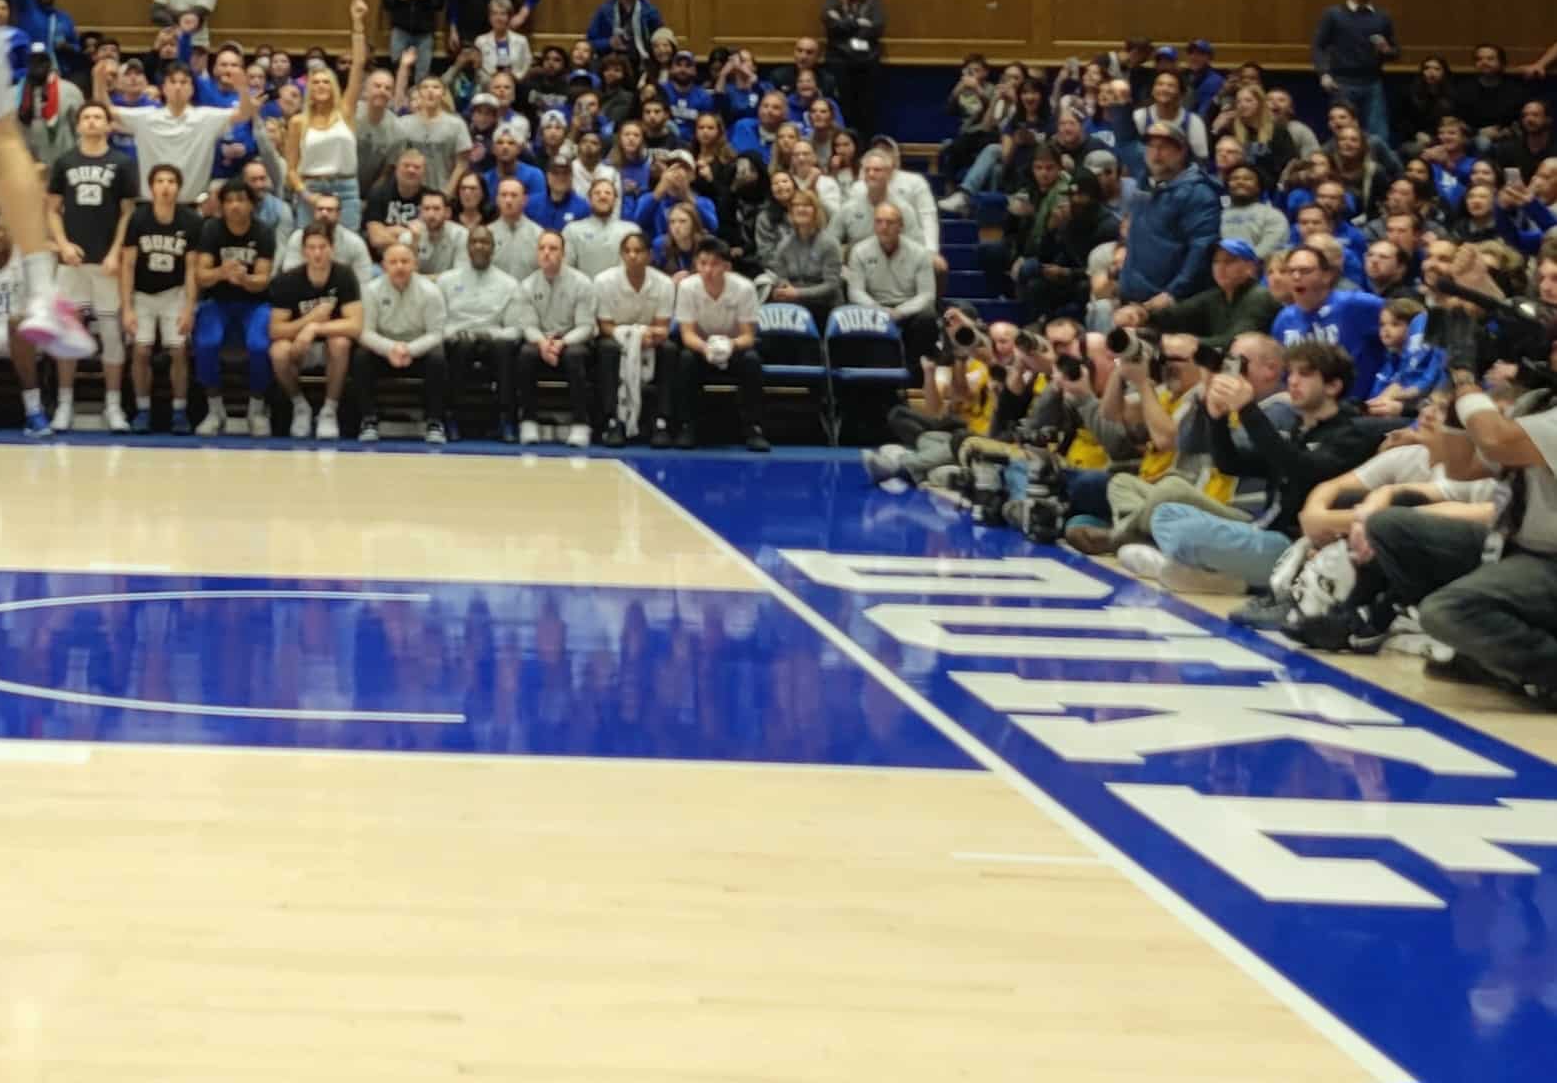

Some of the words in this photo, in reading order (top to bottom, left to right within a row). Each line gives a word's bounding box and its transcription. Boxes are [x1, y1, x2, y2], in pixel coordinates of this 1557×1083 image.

[66, 165, 116, 188] DUKE
[139, 232, 188, 256] DUKE
[838, 307, 892, 334] DUKE
